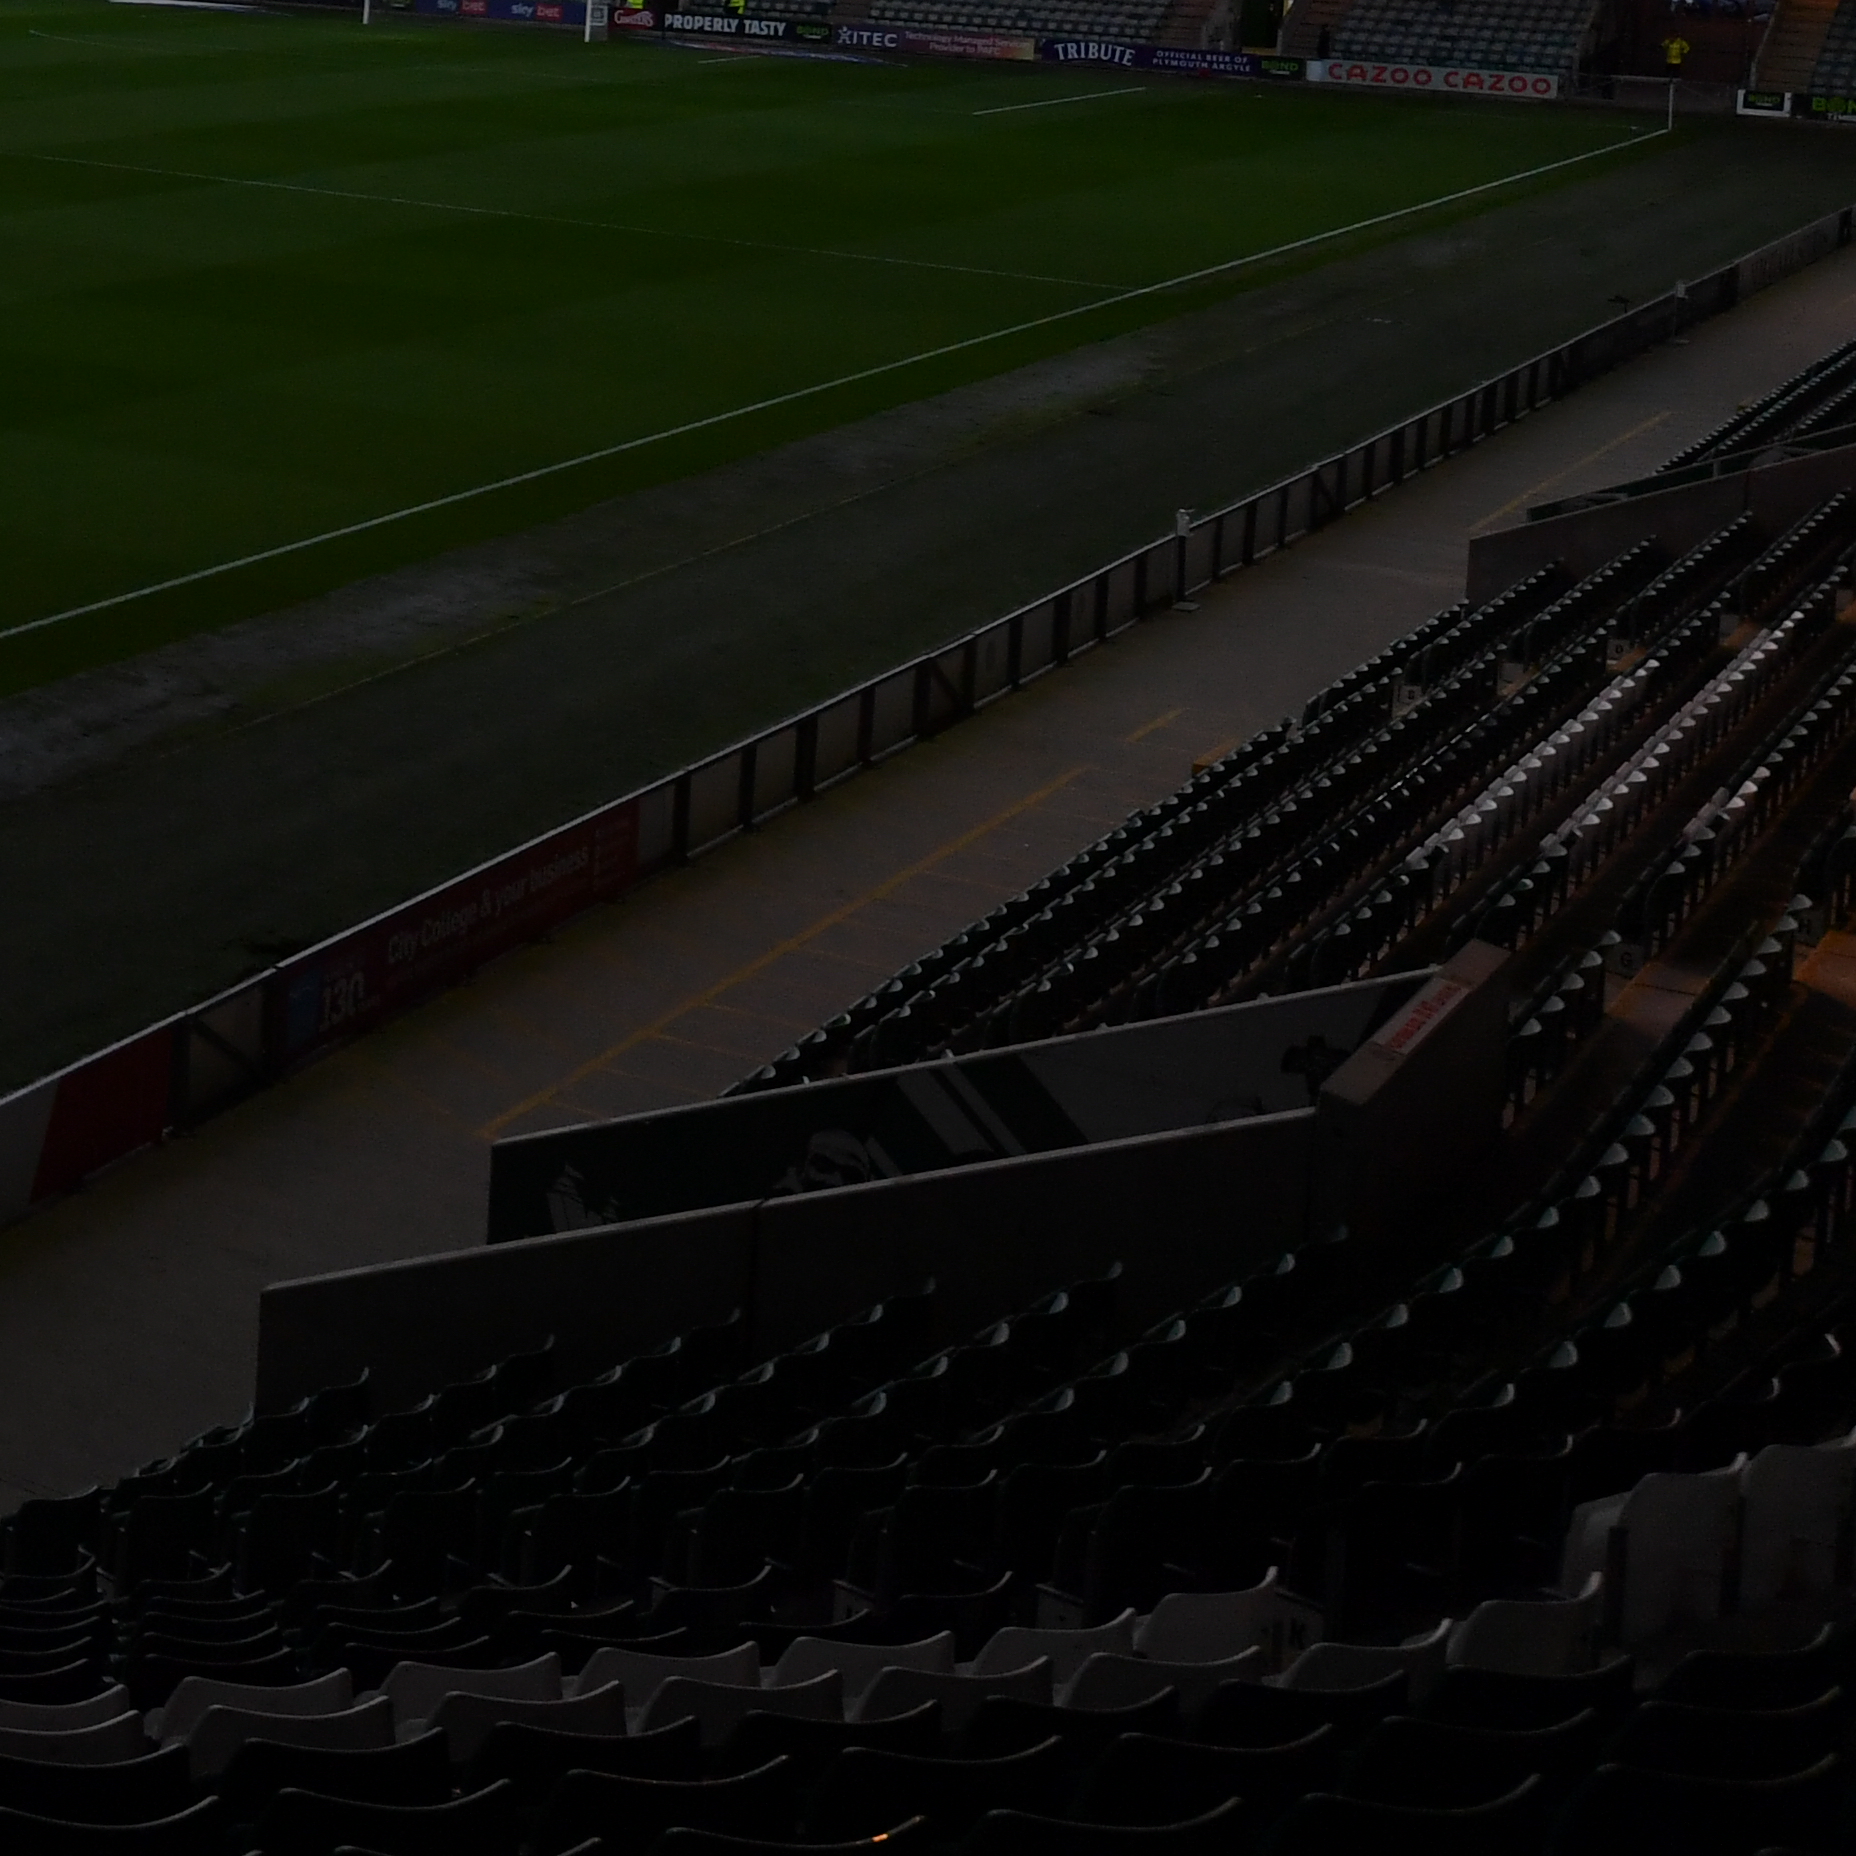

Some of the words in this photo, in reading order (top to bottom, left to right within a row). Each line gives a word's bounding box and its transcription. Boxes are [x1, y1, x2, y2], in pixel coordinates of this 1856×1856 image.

[511, 1, 534, 18] sky
[537, 2, 561, 18] bet
[663, 12, 739, 34] PROPERLY
[742, 18, 788, 37] TASTY
[1052, 42, 1136, 66] TRIBUTE
[1152, 58, 1209, 69] PLYMOUTH
[1211, 62, 1251, 73] ARGYLE
[1156, 50, 1202, 61] OFFICIAL
[1205, 52, 1231, 63] BEER
[1233, 55, 1248, 64] OF
[1328, 62, 1433, 86] CAZOO
[1443, 71, 1552, 95] CAZOO
[386, 927, 420, 966] City
[421, 902, 478, 948] College
[481, 891, 494, 917] &
[494, 877, 529, 913] your
[527, 846, 591, 893] business
[1620, 951, 1633, 967] G
[318, 969, 367, 1033] 130
